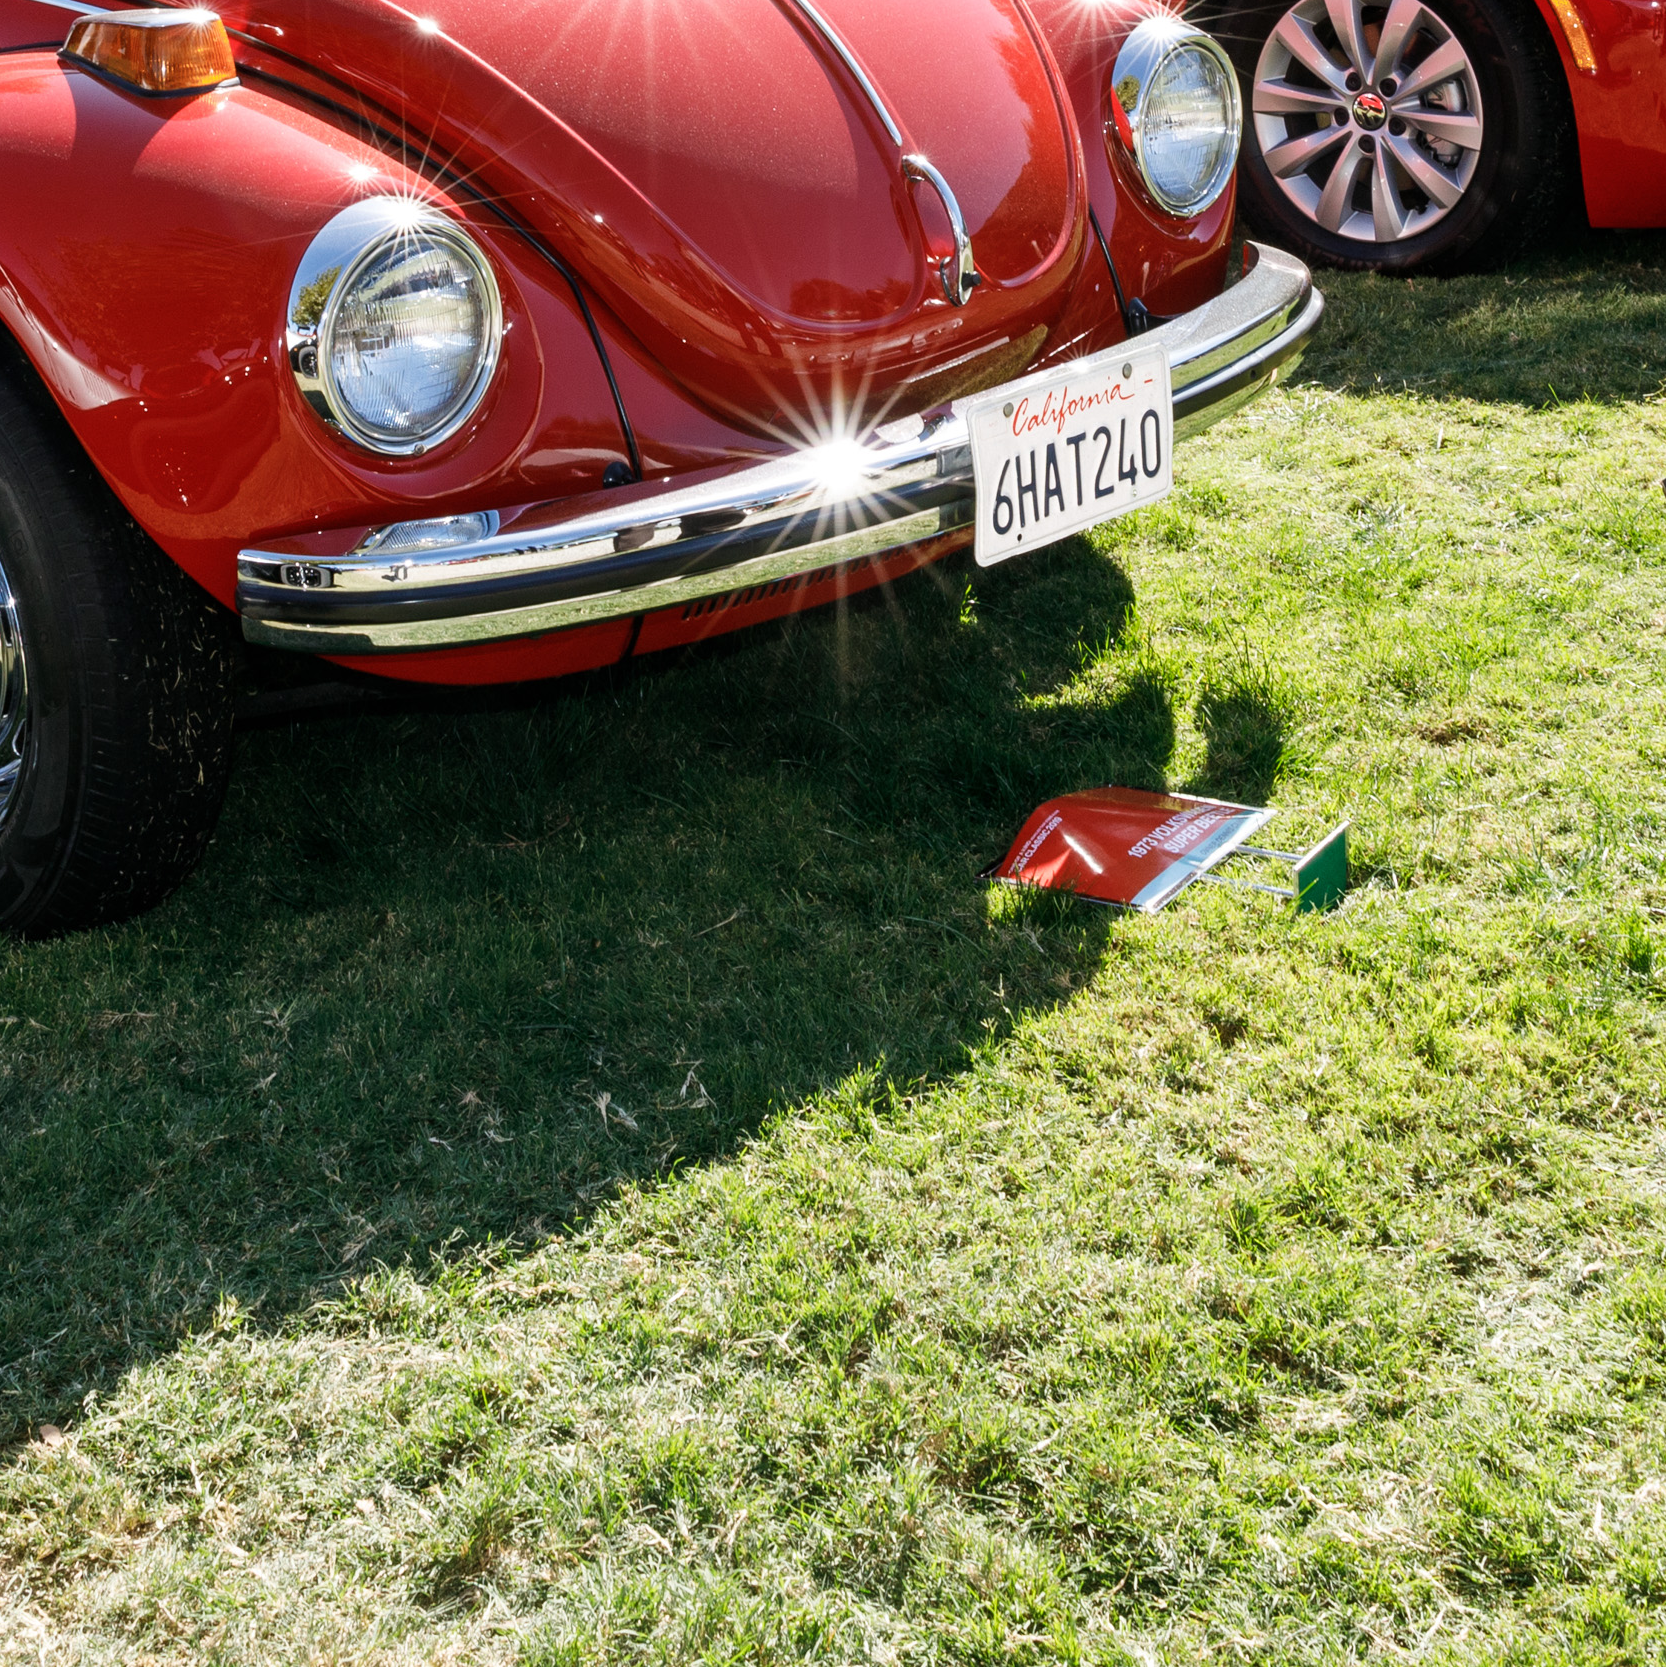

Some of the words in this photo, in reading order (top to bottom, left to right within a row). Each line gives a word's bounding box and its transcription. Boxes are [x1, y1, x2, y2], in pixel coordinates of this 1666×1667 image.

[1012, 377, 1135, 437] California
[992, 408, 1162, 536] 6HAT240
[1024, 828, 1051, 858] CLASSIC
[1127, 836, 1159, 859] 1973
[1163, 824, 1204, 854] SUPER
